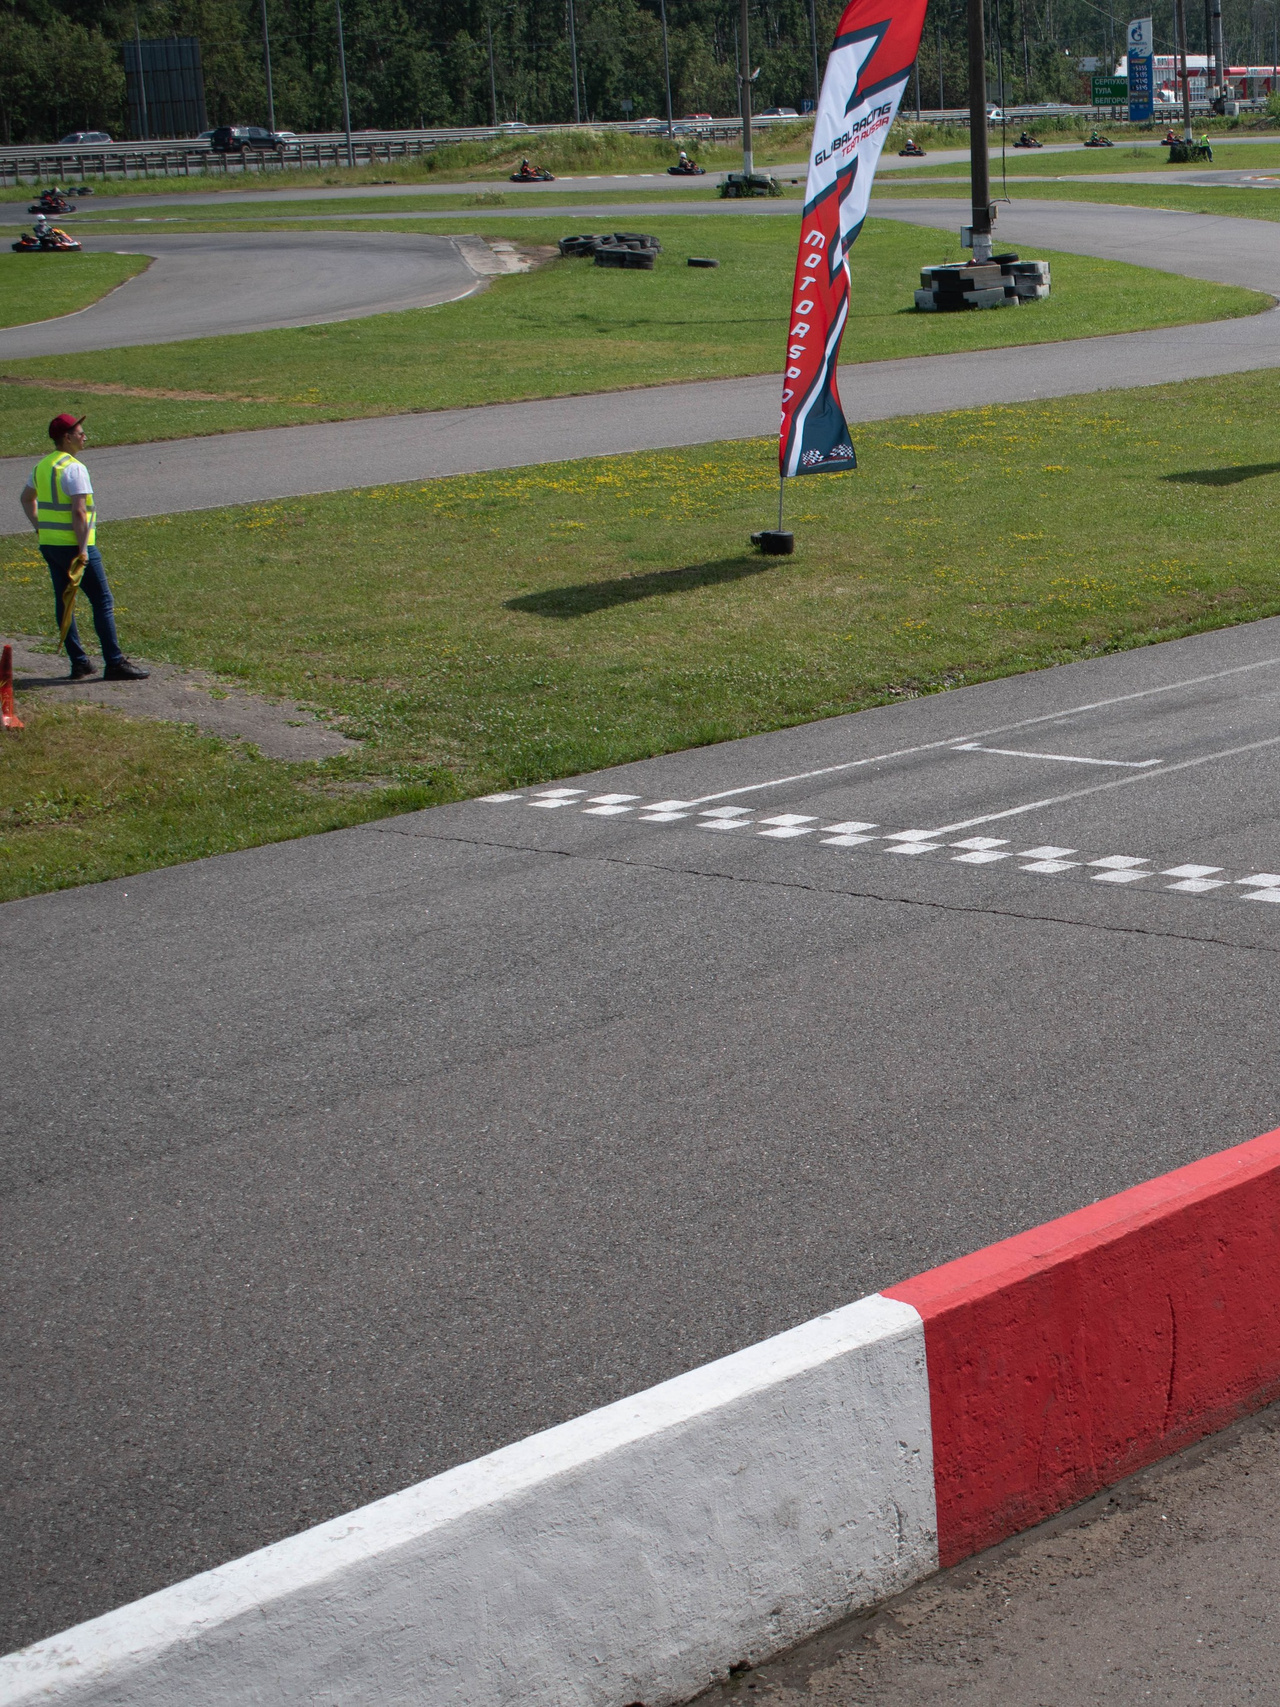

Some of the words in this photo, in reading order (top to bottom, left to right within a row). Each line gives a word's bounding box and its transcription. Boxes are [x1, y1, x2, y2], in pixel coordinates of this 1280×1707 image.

[841, 135, 860, 157] TEAM
[860, 116, 890, 141] RUSSIA
[852, 101, 893, 136] RACING
